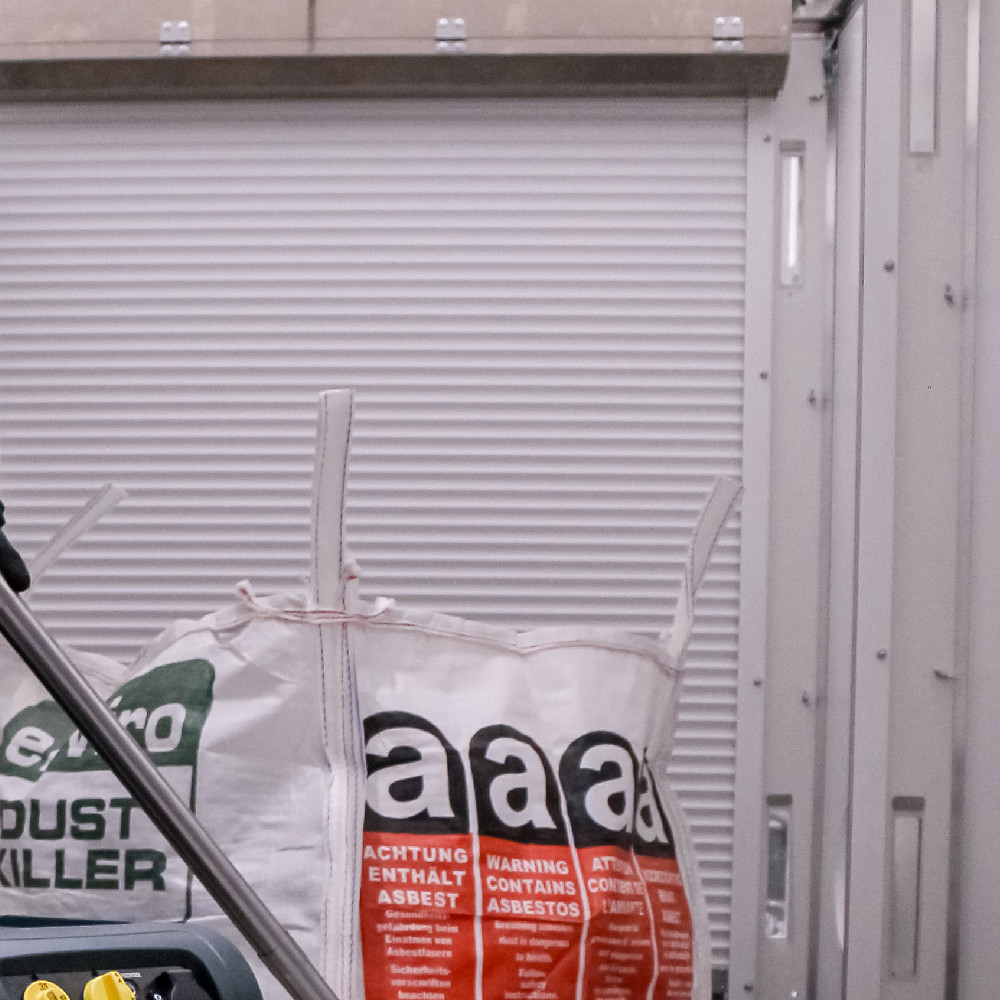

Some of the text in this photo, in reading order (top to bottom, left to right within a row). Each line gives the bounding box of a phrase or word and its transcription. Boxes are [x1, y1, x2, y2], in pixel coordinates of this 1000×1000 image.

[0, 798, 142, 840] DUST
[364, 845, 468, 863] ACHTUNG
[486, 854, 569, 875] WARNING
[368, 866, 466, 886] ENTHÄLT
[486, 876, 576, 895] CONTAINS
[378, 889, 459, 908] ASBEST
[487, 898, 580, 917] ASBESTOS
